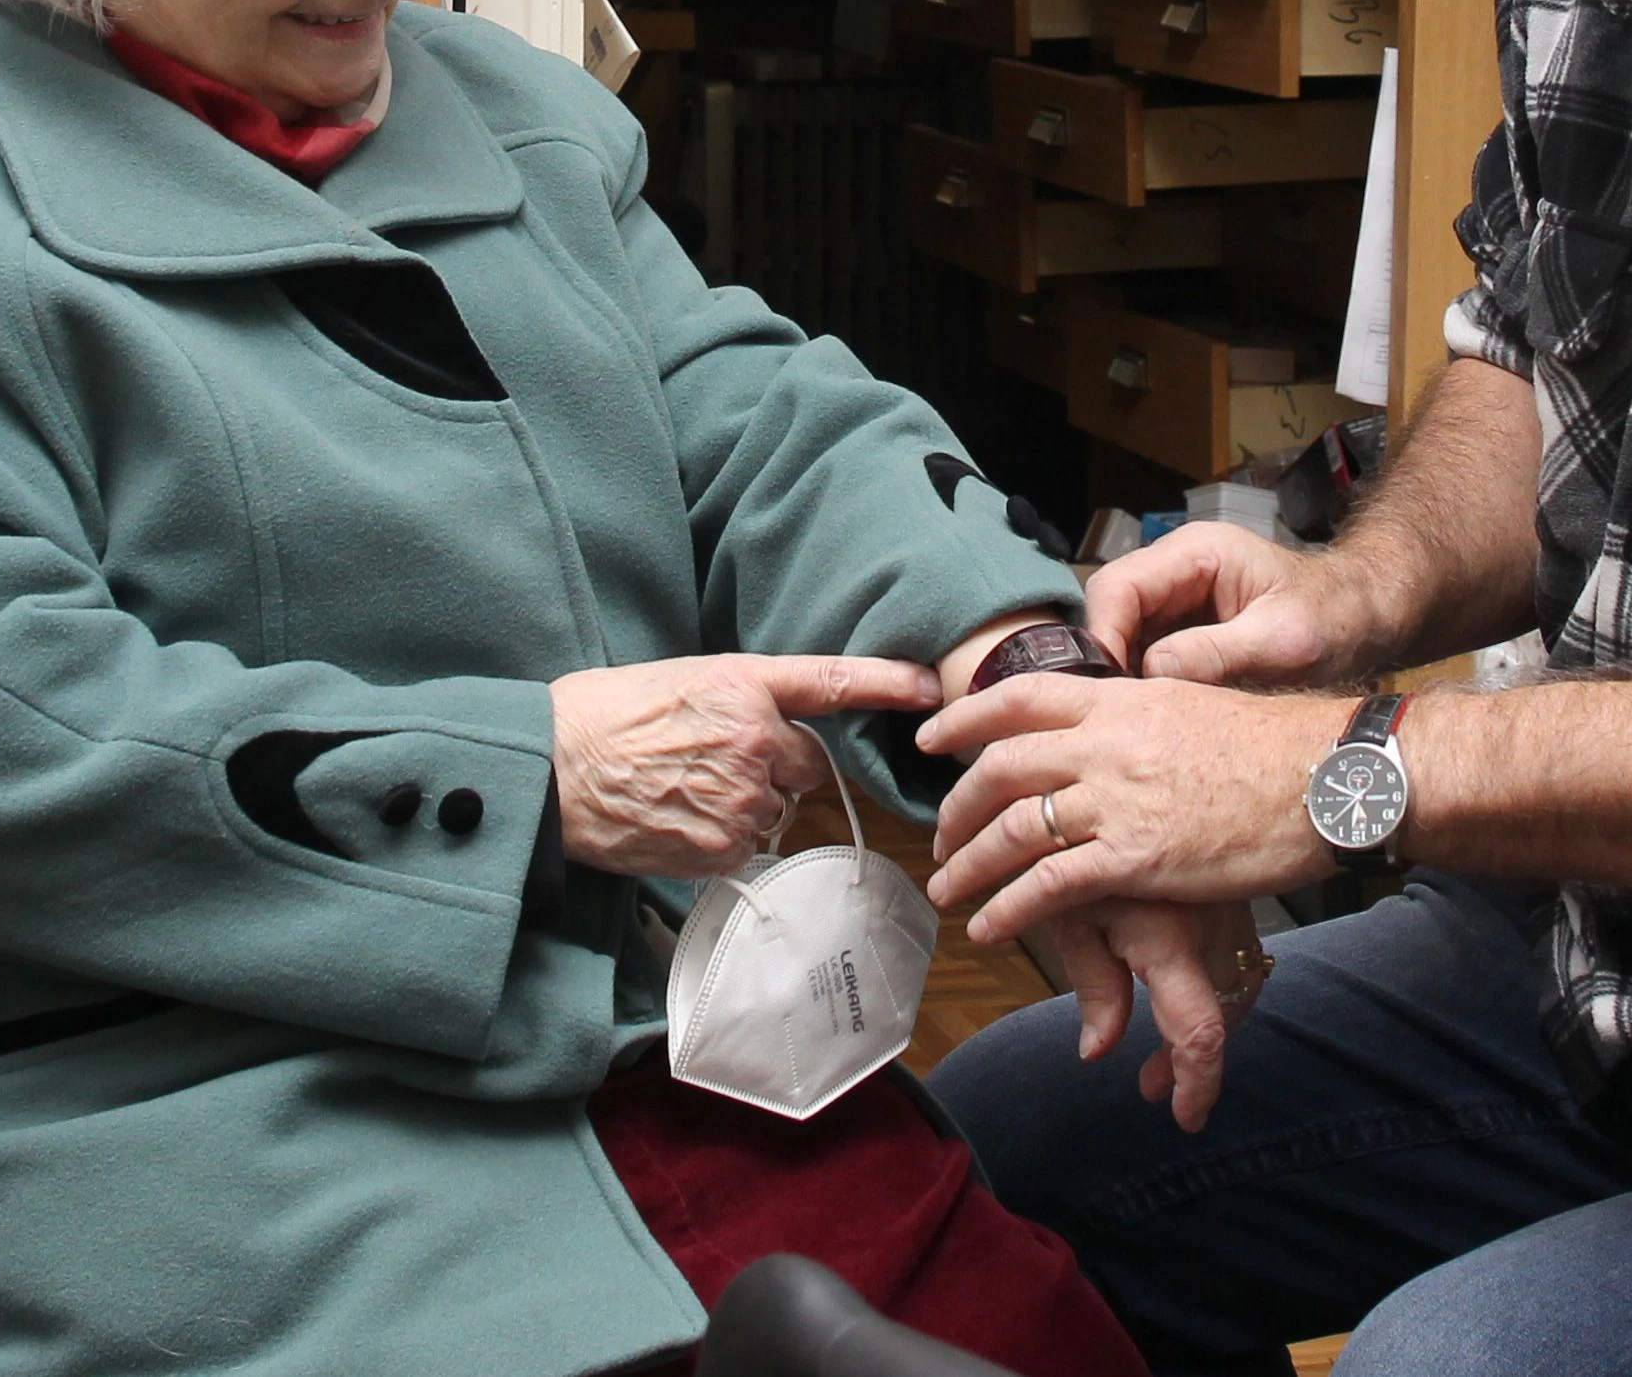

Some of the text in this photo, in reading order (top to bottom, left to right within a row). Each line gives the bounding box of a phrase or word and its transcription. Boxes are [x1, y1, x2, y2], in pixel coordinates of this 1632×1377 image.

[1386, 772, 1397, 784] 8
[1392, 791, 1402, 803] 9
[1382, 808, 1395, 821] 10
[1371, 823, 1383, 836] 11
[1351, 830, 1366, 843] 12
[840, 949, 865, 1034] LEIKANG
